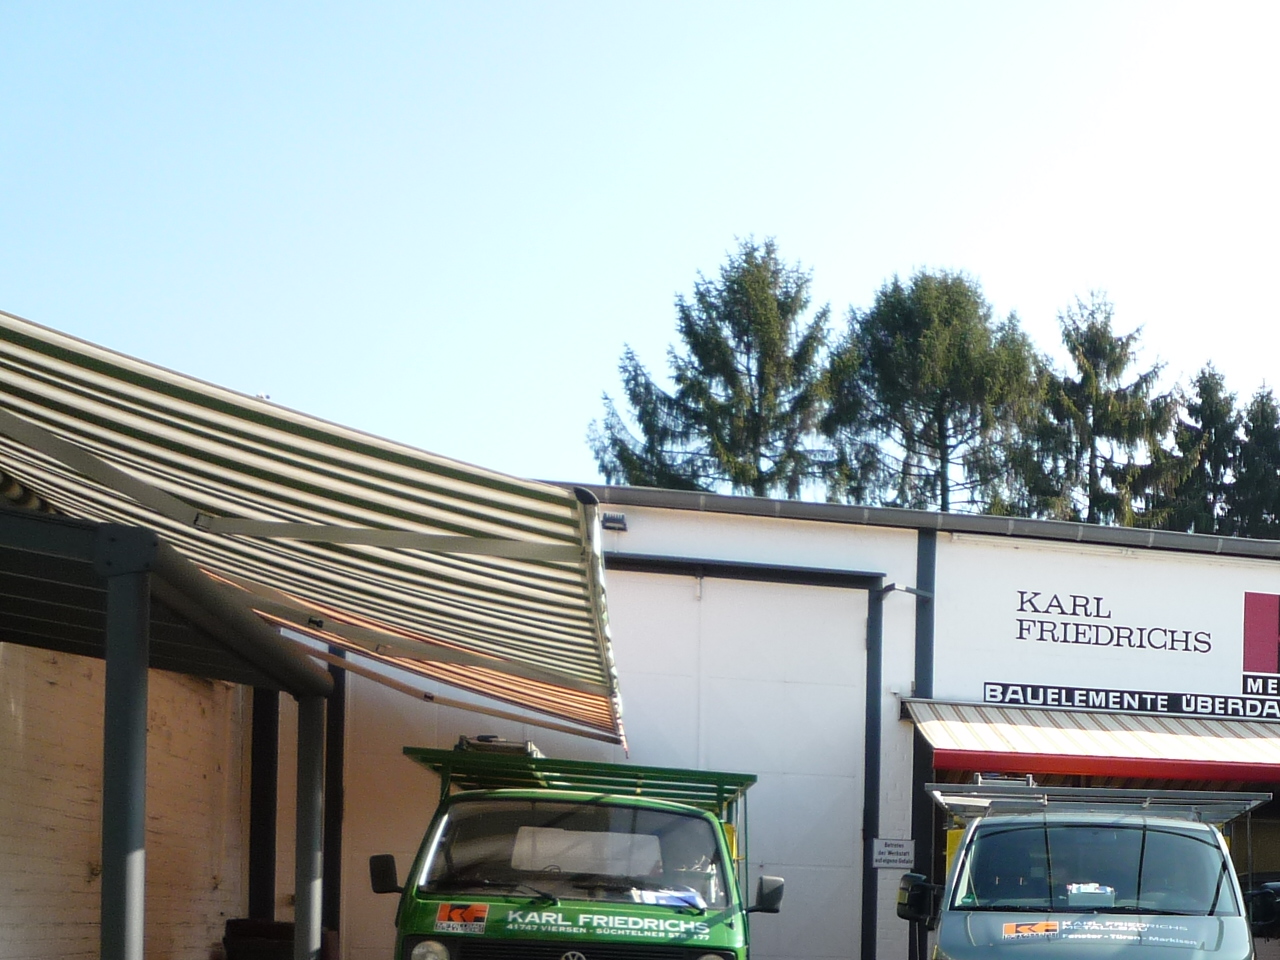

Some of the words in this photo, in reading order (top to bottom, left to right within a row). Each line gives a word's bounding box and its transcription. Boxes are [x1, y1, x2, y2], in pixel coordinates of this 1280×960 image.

[1016, 590, 1112, 619] KARL
[1015, 618, 1212, 654] FRIEDRICHS
[985, 684, 1168, 711] BAUELEMENTE
[506, 923, 538, 931] 41747
[540, 925, 587, 934] VIERSEN
[596, 927, 666, 938] SÜCHTELNER
[507, 910, 572, 926] KARL
[578, 913, 711, 934] FRIEDRICHS
[1105, 920, 1188, 931] FRIEDRICHS
[1149, 936, 1197, 946] Markisen
